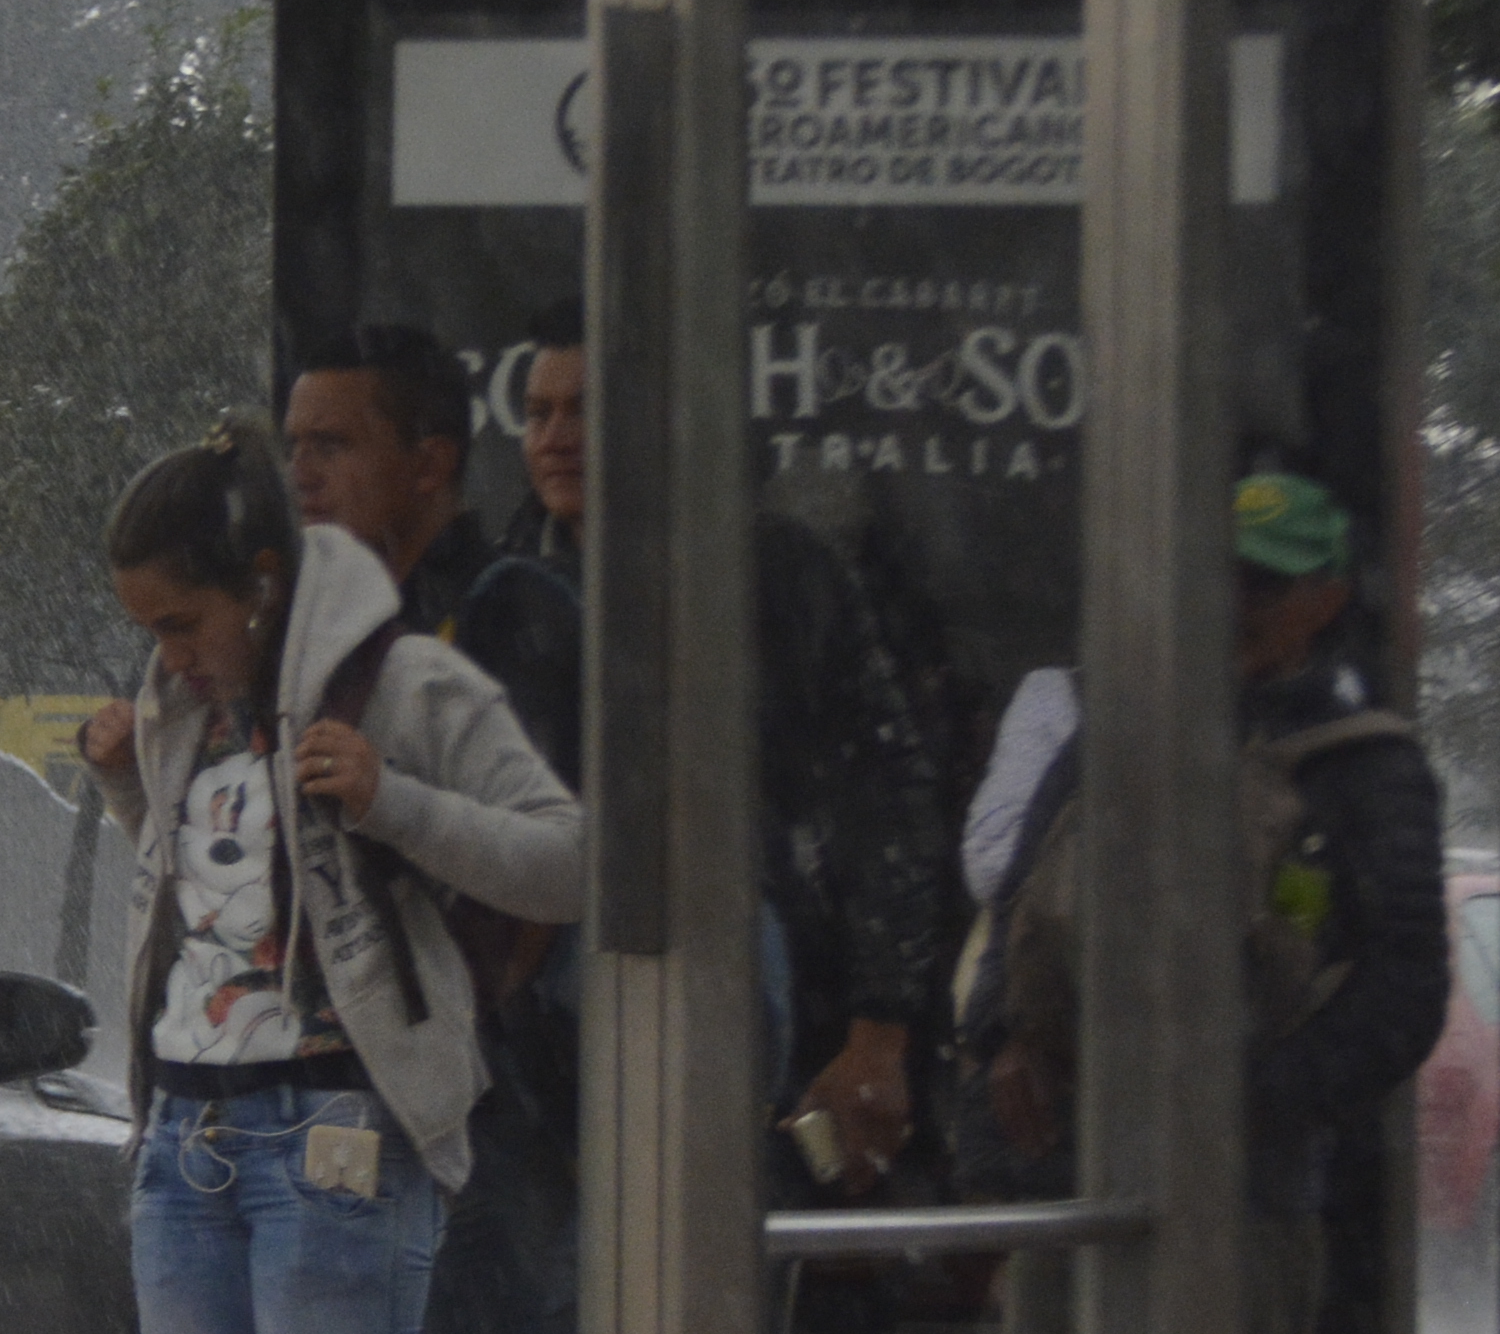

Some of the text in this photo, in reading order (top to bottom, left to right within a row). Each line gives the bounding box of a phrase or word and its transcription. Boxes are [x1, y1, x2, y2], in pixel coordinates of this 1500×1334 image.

[750, 155, 1083, 185] EATRO DE BOGOT
[867, 341, 921, 411] &
[961, 326, 1085, 429] SO
[770, 433, 1039, 480] TRALIA
